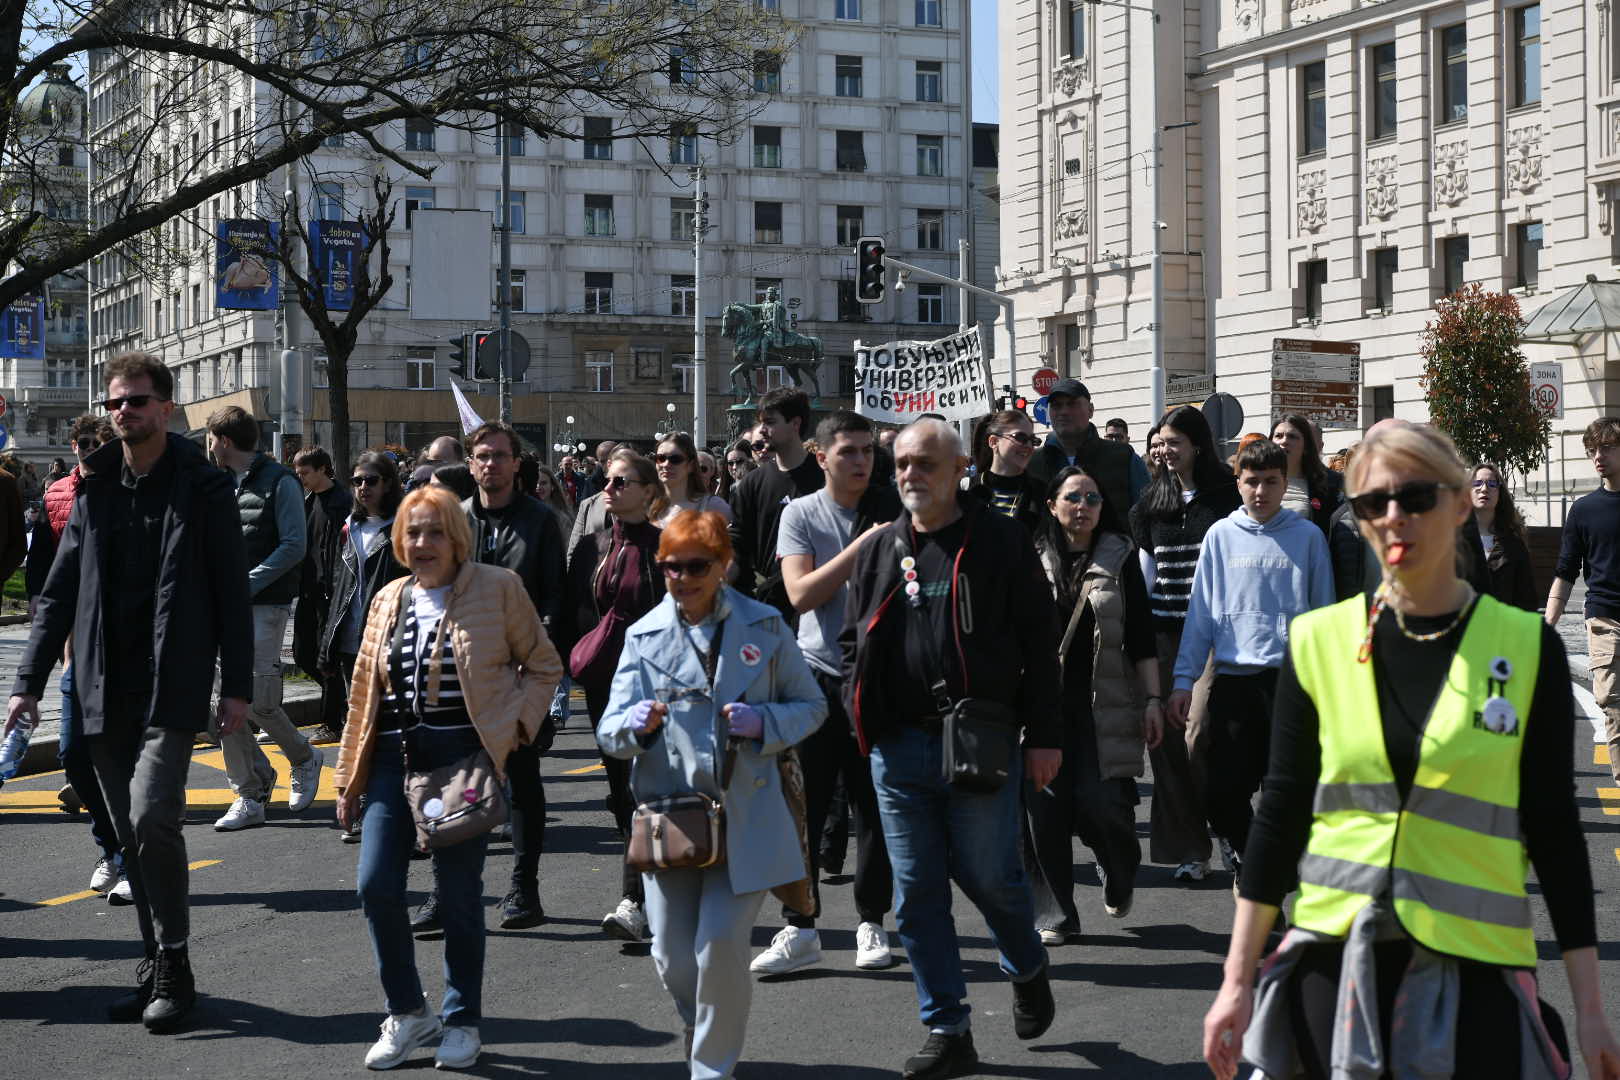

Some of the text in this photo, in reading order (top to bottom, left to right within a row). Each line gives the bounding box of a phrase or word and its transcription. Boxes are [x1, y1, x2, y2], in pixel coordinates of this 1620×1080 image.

[855, 330, 981, 369] ПОБУЊЕНИ
[855, 357, 982, 391] УНИВЕРЗИТЕТ
[1035, 377, 1057, 388] STOP
[1537, 370, 1557, 379] ЗОНА
